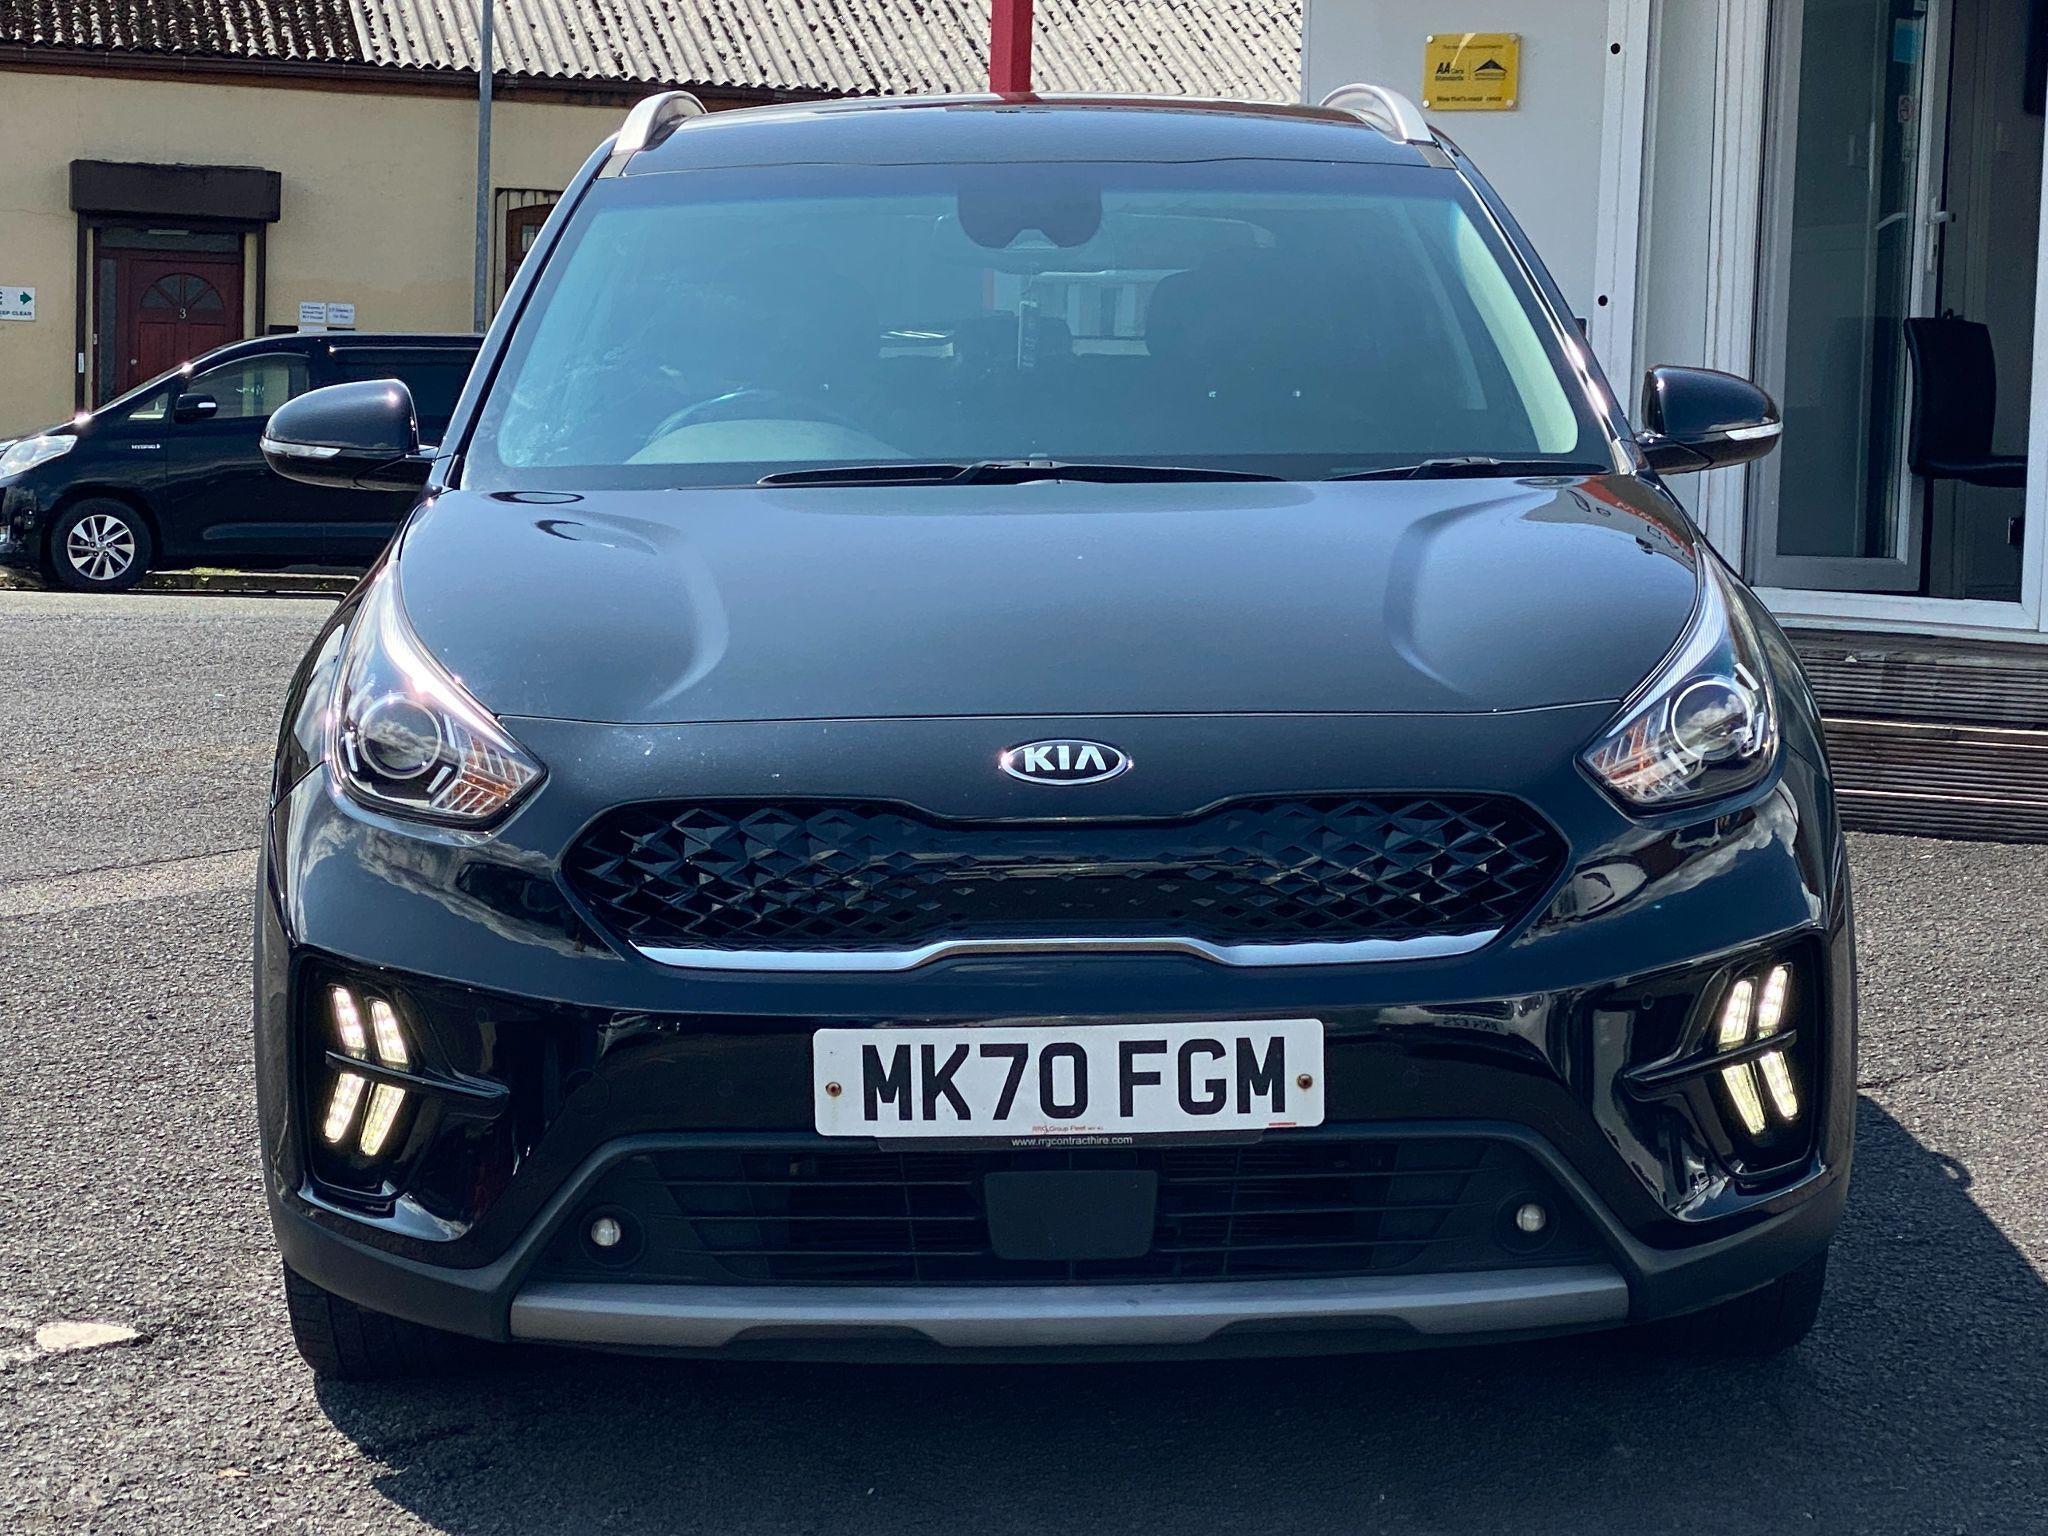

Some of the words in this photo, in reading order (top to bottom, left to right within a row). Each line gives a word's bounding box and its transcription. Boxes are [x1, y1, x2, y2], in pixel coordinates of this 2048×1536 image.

[1436, 62, 1451, 74] AA
[179, 307, 187, 319] 3
[1022, 745, 1107, 773] KIA
[862, 1042, 1088, 1121] MK70
[1118, 1036, 1286, 1118] FGM
[1011, 1135, 1134, 1147] www.rrgcontracthire.com
